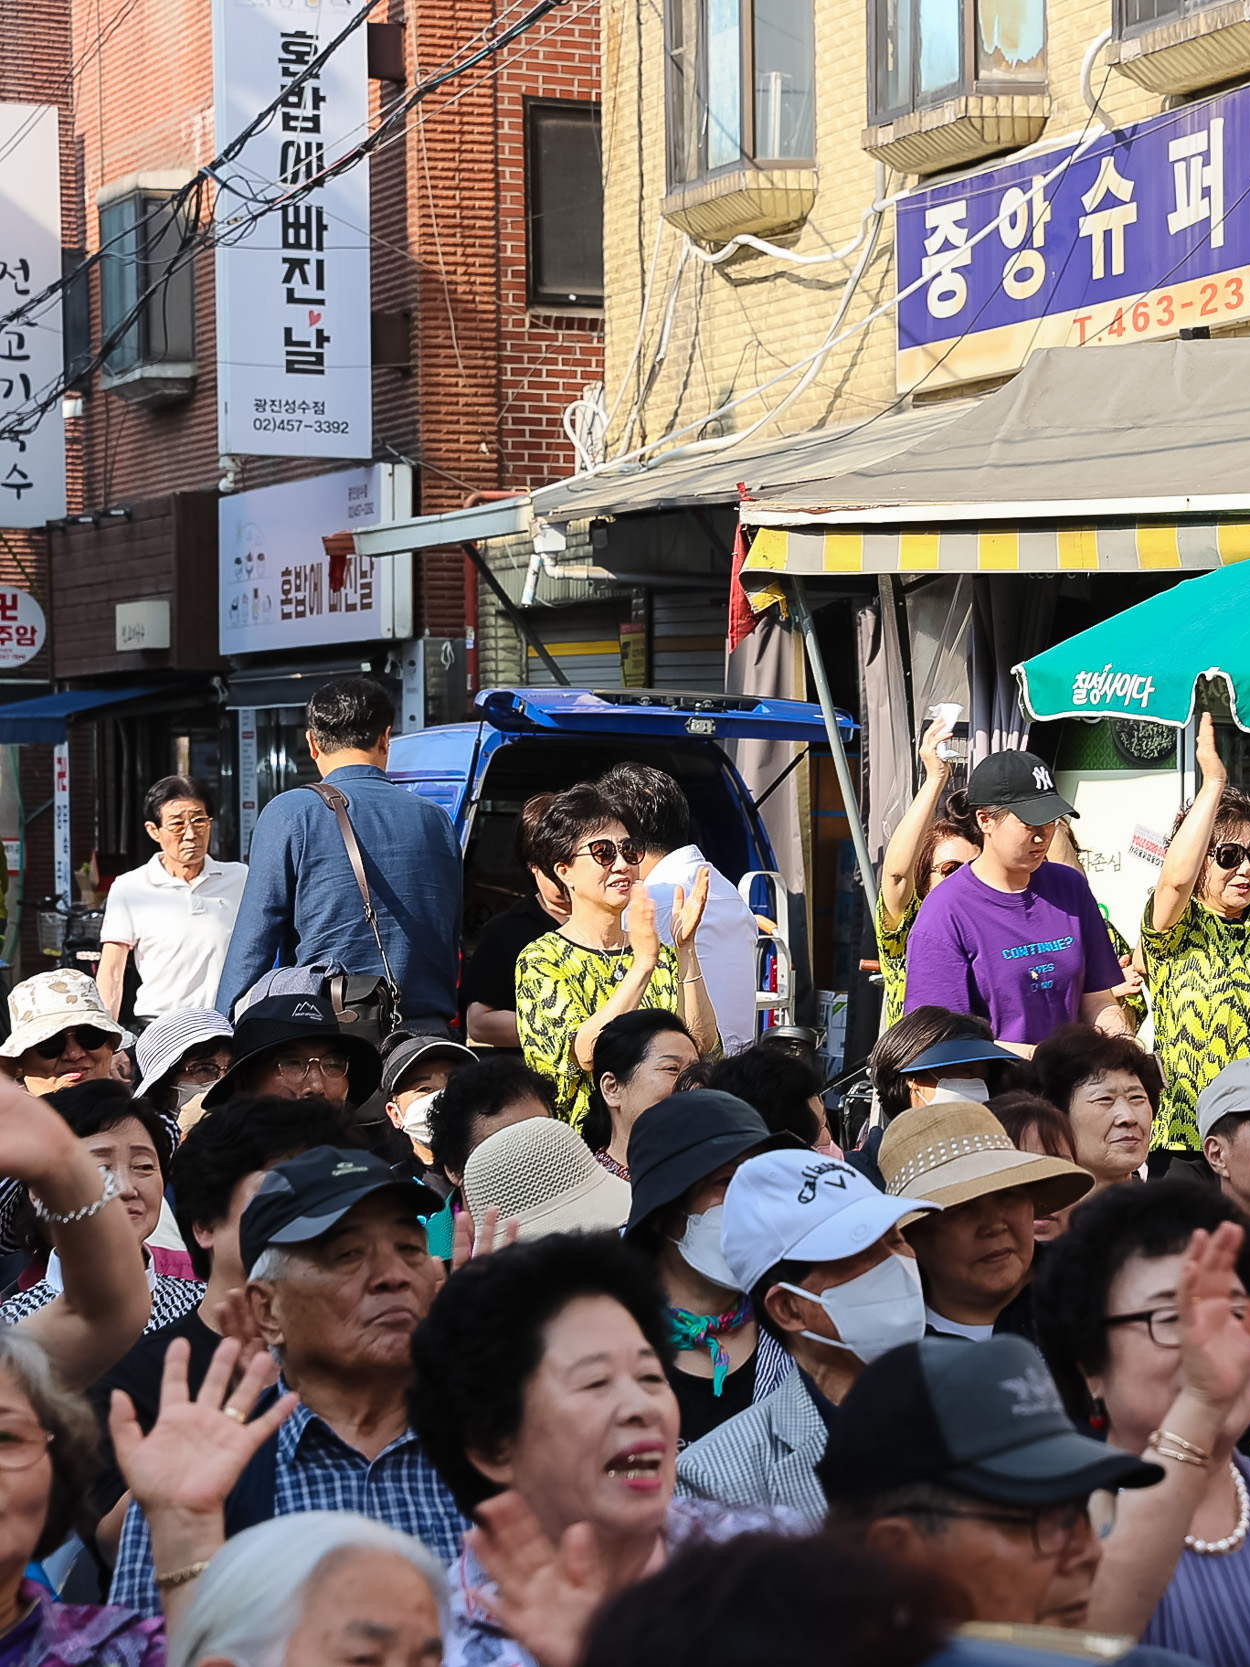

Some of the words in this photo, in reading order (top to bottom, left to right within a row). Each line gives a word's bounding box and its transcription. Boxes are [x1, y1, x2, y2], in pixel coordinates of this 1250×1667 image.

[253, 398, 326, 415] 광진성수점
[252, 417, 350, 434] 02)457-3392
[280, 562, 323, 621] 혼밥에
[1072, 665, 1156, 708] 칠성사이다
[1032, 765, 1054, 791] NY
[1002, 935, 1075, 960] CONTINUE?
